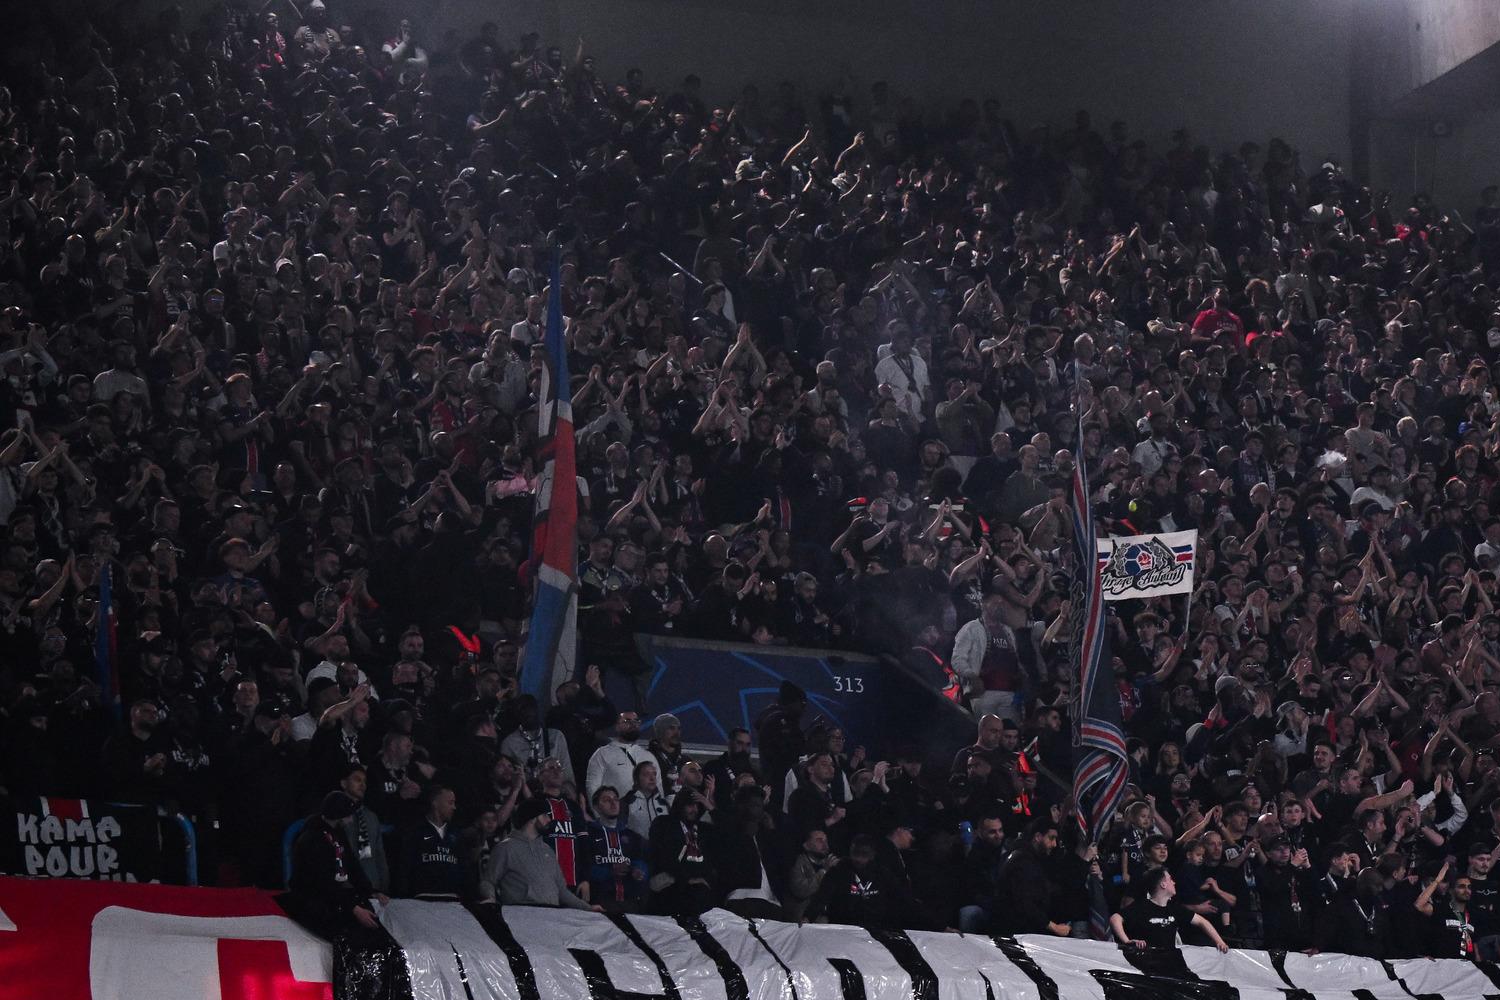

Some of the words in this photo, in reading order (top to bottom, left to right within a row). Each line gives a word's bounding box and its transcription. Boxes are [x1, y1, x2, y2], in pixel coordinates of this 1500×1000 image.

[833, 676, 864, 693] 313
[17, 812, 121, 845] KAMA
[25, 844, 119, 877] POUR
